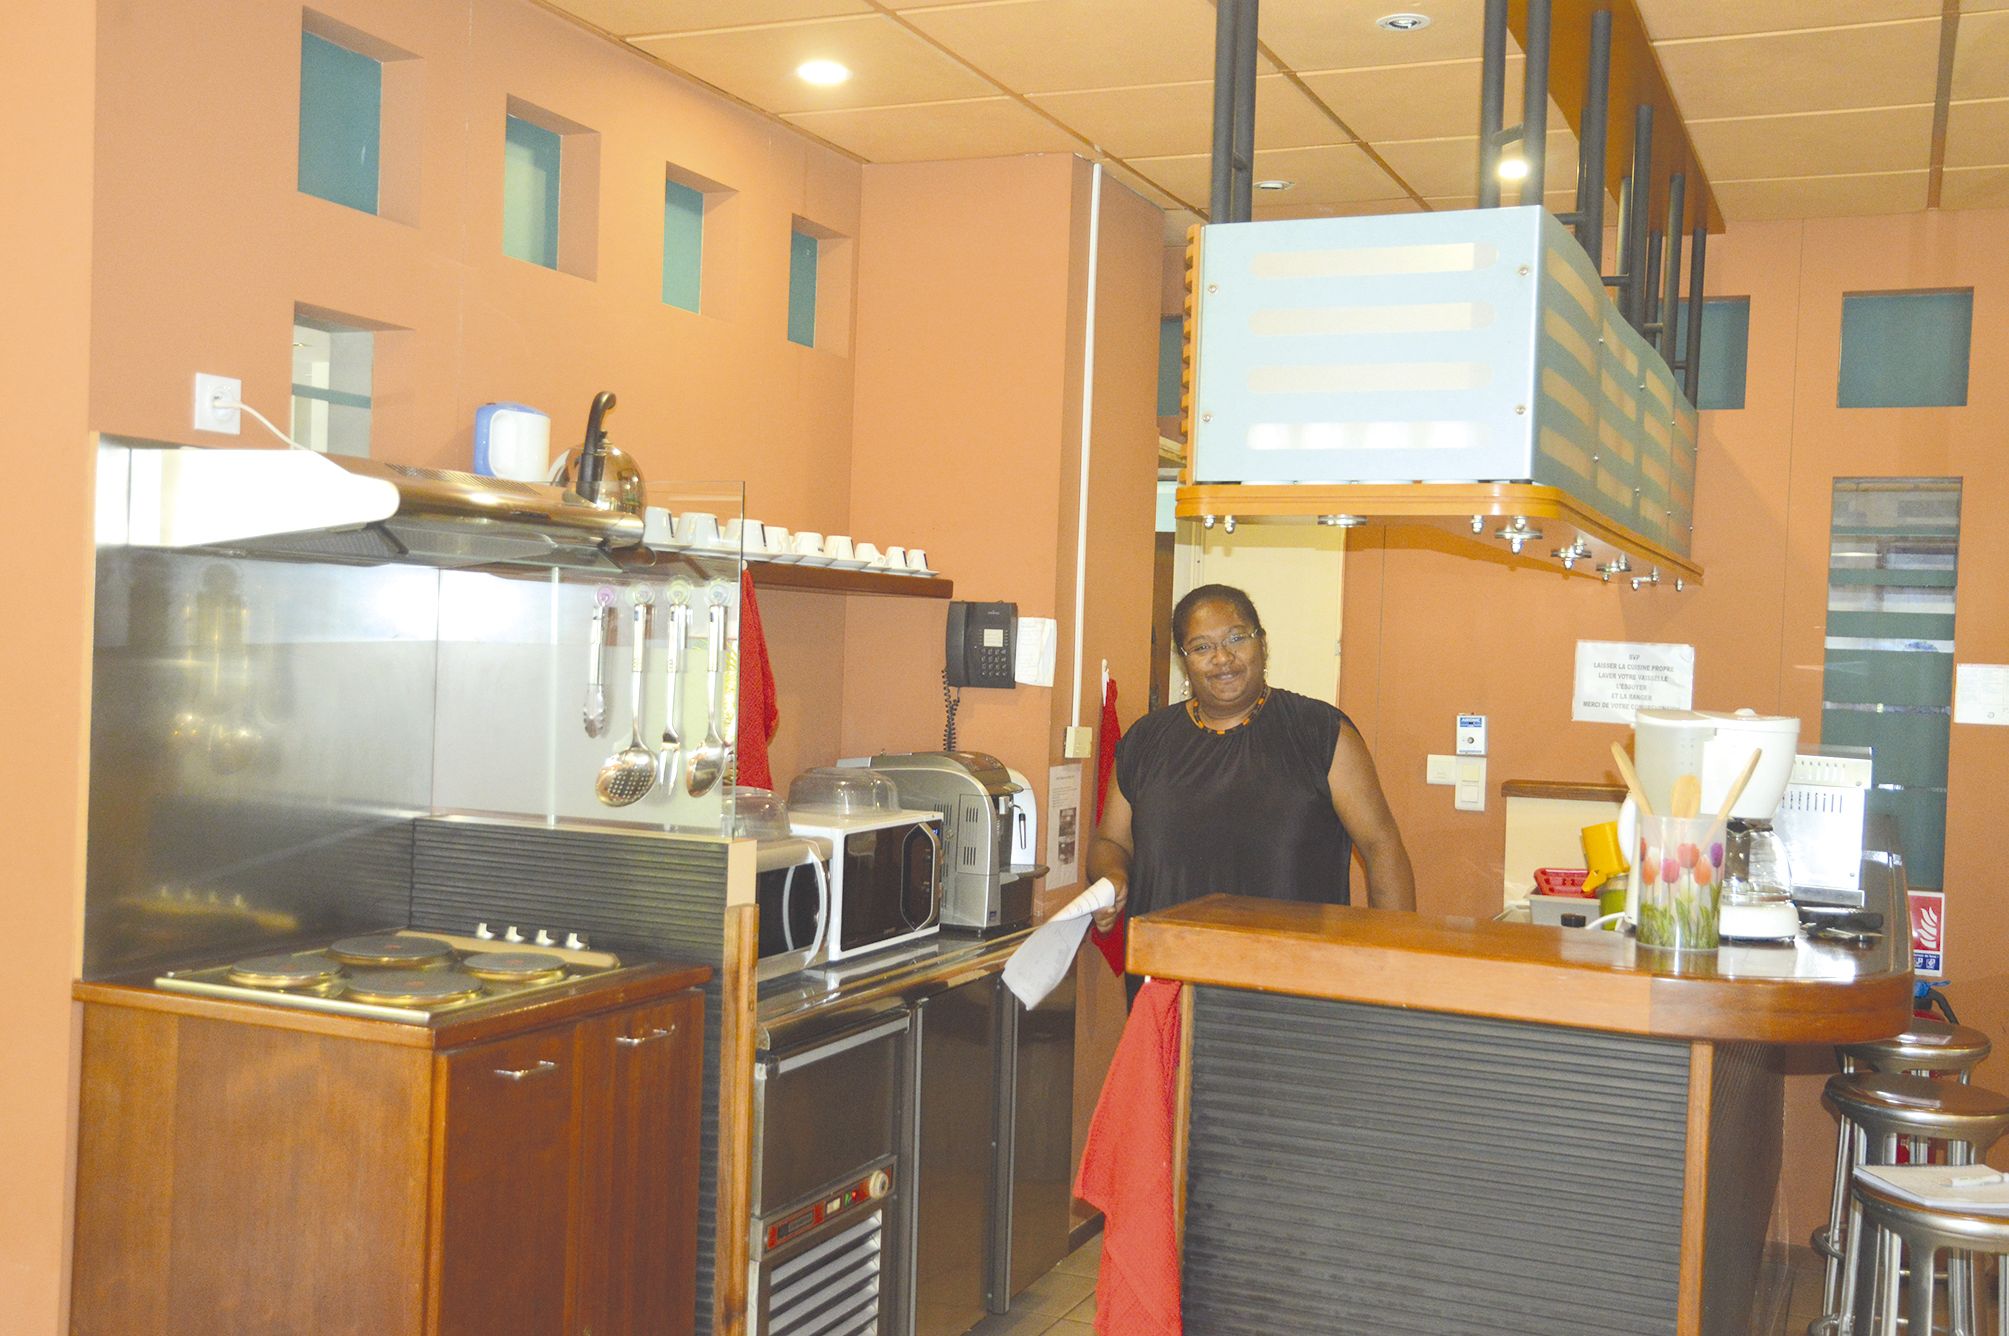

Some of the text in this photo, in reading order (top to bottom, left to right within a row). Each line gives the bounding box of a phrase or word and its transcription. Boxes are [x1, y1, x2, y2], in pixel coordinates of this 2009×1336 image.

[1593, 662, 1617, 670] LAISSER
[1627, 663, 1650, 671] CUISINE
[1651, 664, 1674, 672] PROPRE
[1610, 702, 1629, 710] VOTRE
